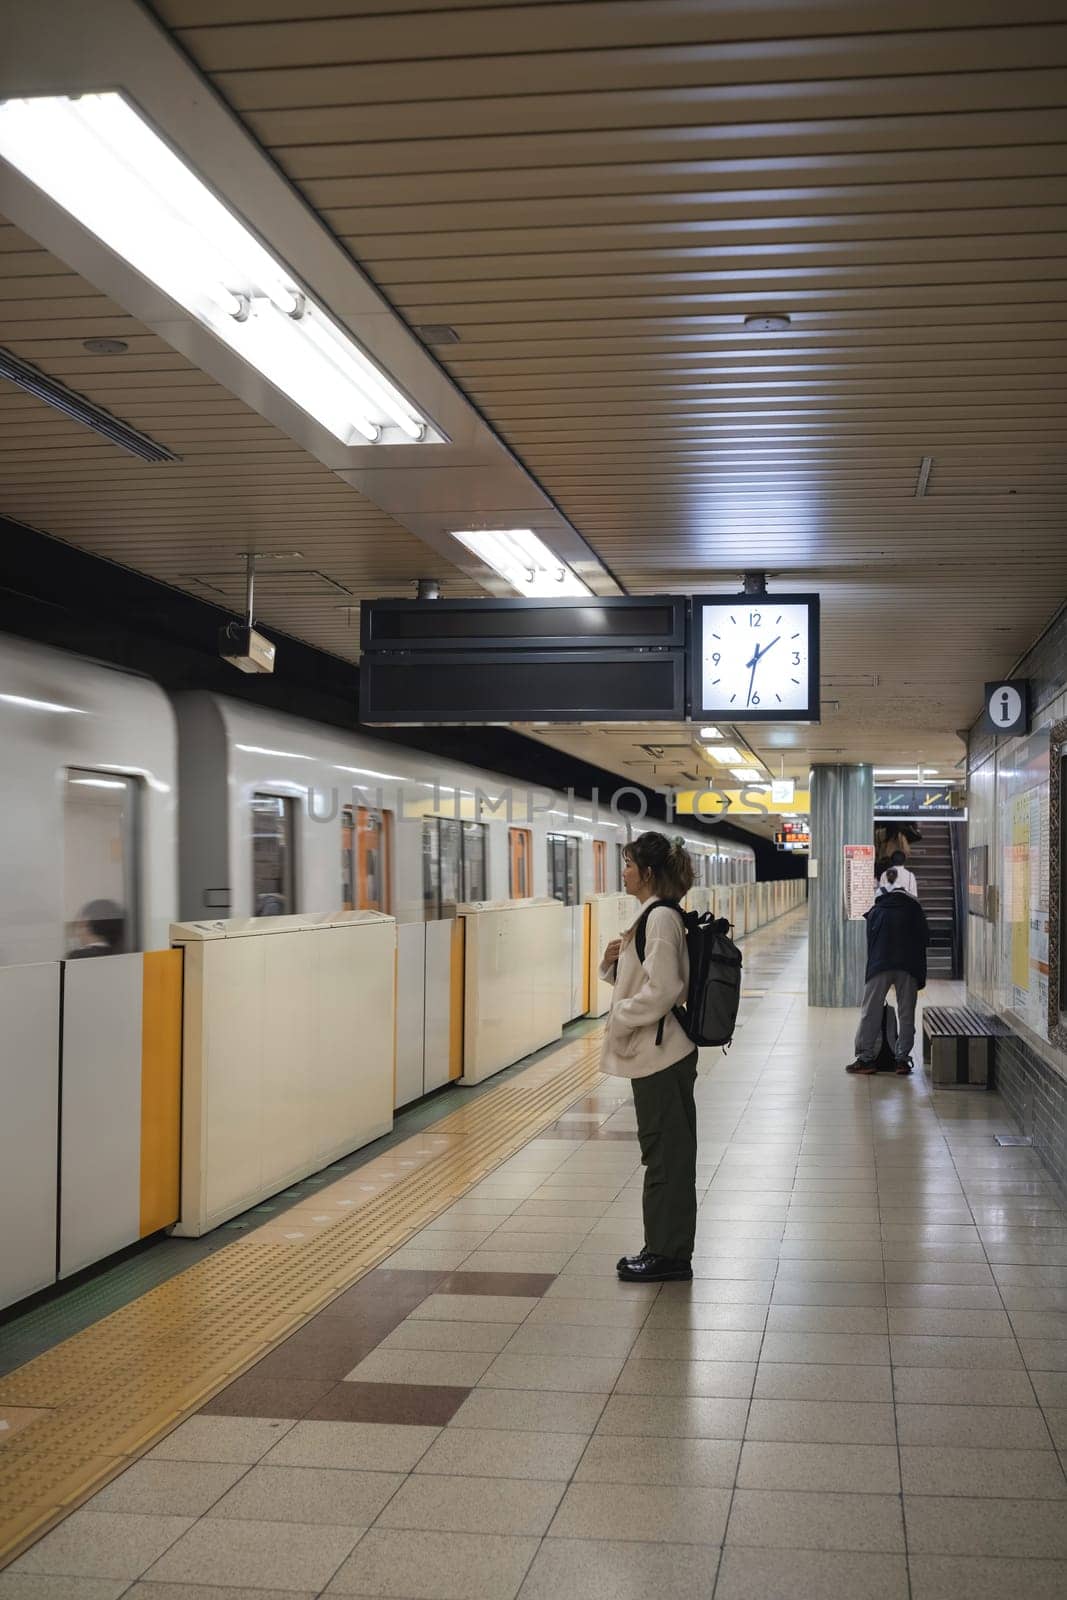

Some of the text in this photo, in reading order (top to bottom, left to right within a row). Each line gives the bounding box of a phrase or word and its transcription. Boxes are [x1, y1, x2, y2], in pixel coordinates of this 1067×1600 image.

[749, 612, 762, 628] 12
[711, 652, 721, 666] 9
[791, 651, 801, 666] 3
[751, 690, 761, 705] 6
